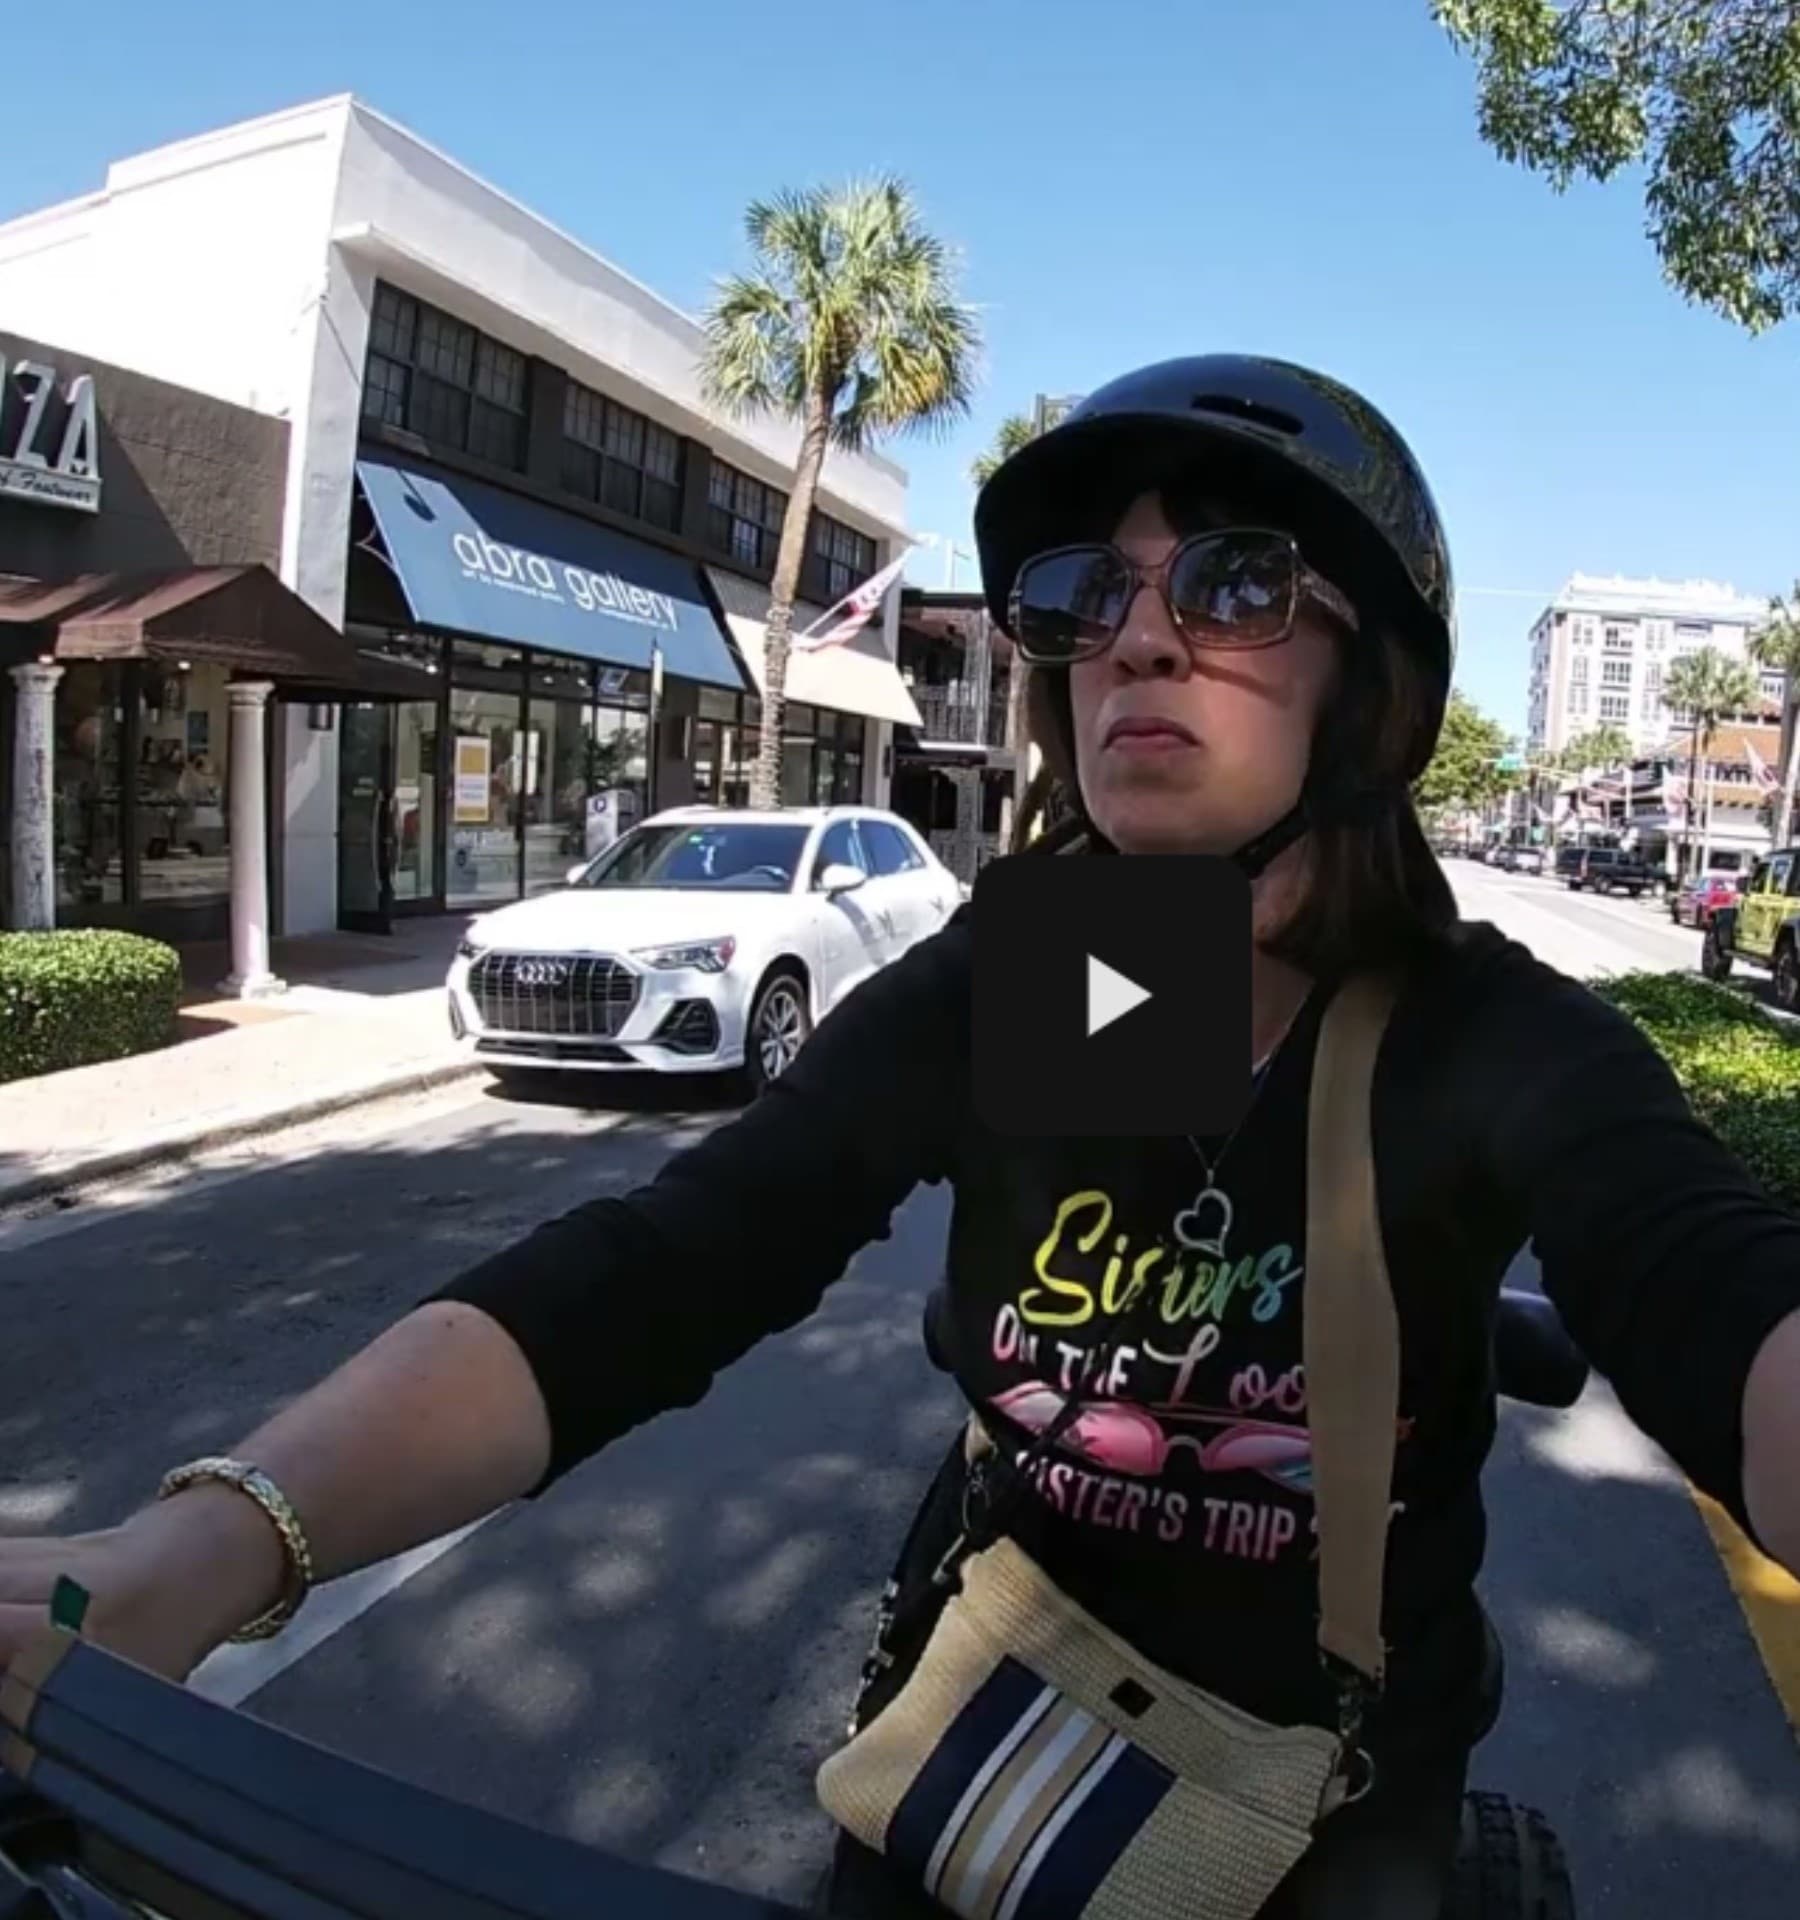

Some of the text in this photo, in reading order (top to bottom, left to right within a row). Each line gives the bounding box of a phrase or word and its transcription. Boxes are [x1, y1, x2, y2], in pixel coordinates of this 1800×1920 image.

[0, 354, 99, 481] ZA
[453, 530, 557, 592] abra
[563, 566, 678, 632] gallery
[1203, 1497, 1296, 1561] TRIP
